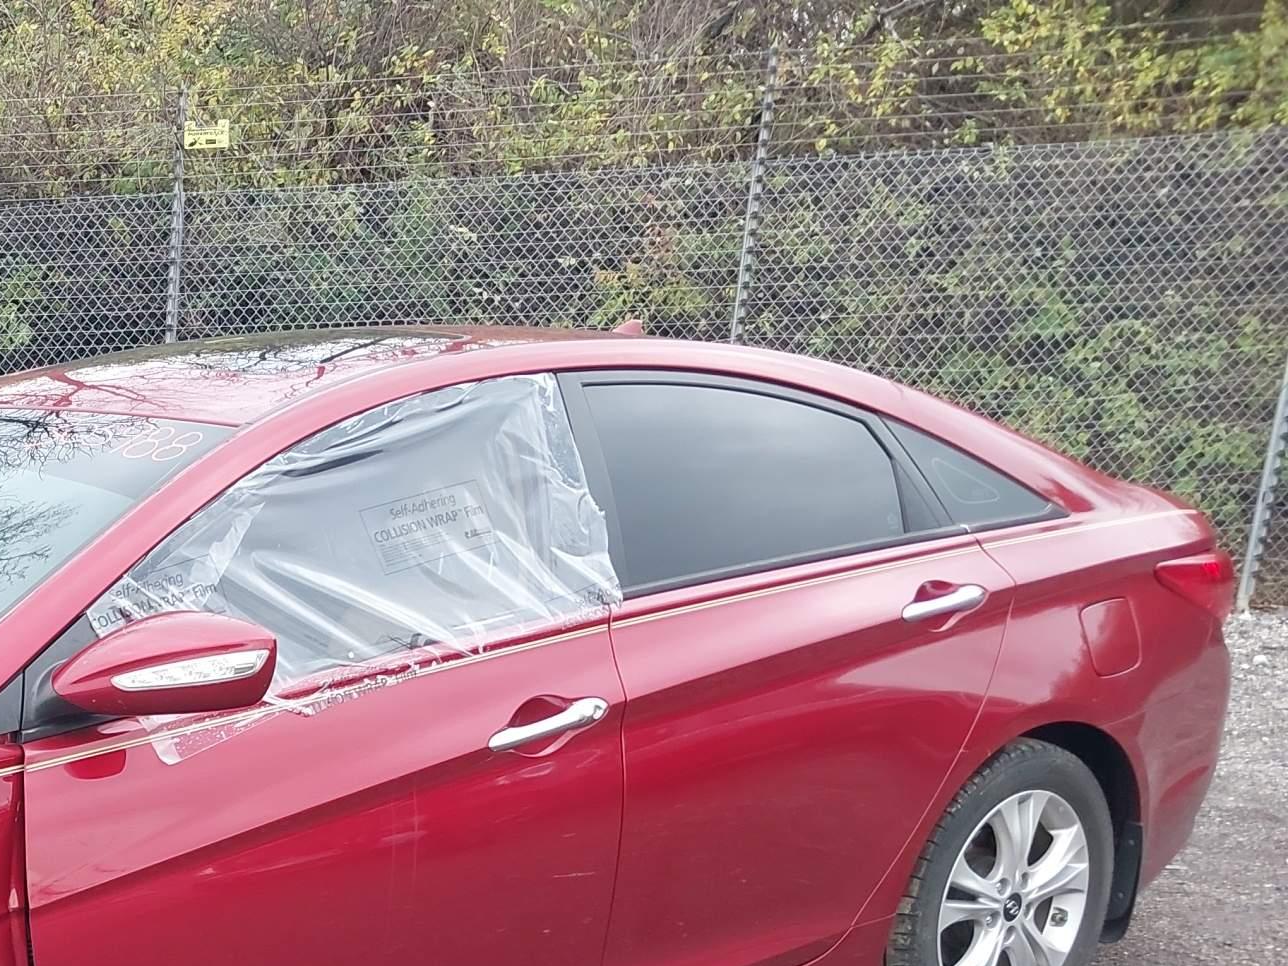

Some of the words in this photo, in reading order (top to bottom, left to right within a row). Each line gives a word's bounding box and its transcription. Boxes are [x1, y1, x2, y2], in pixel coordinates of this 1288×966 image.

[389, 493, 457, 520] Self-Adhering
[374, 519, 427, 543] COLLISION
[463, 504, 485, 519] Film
